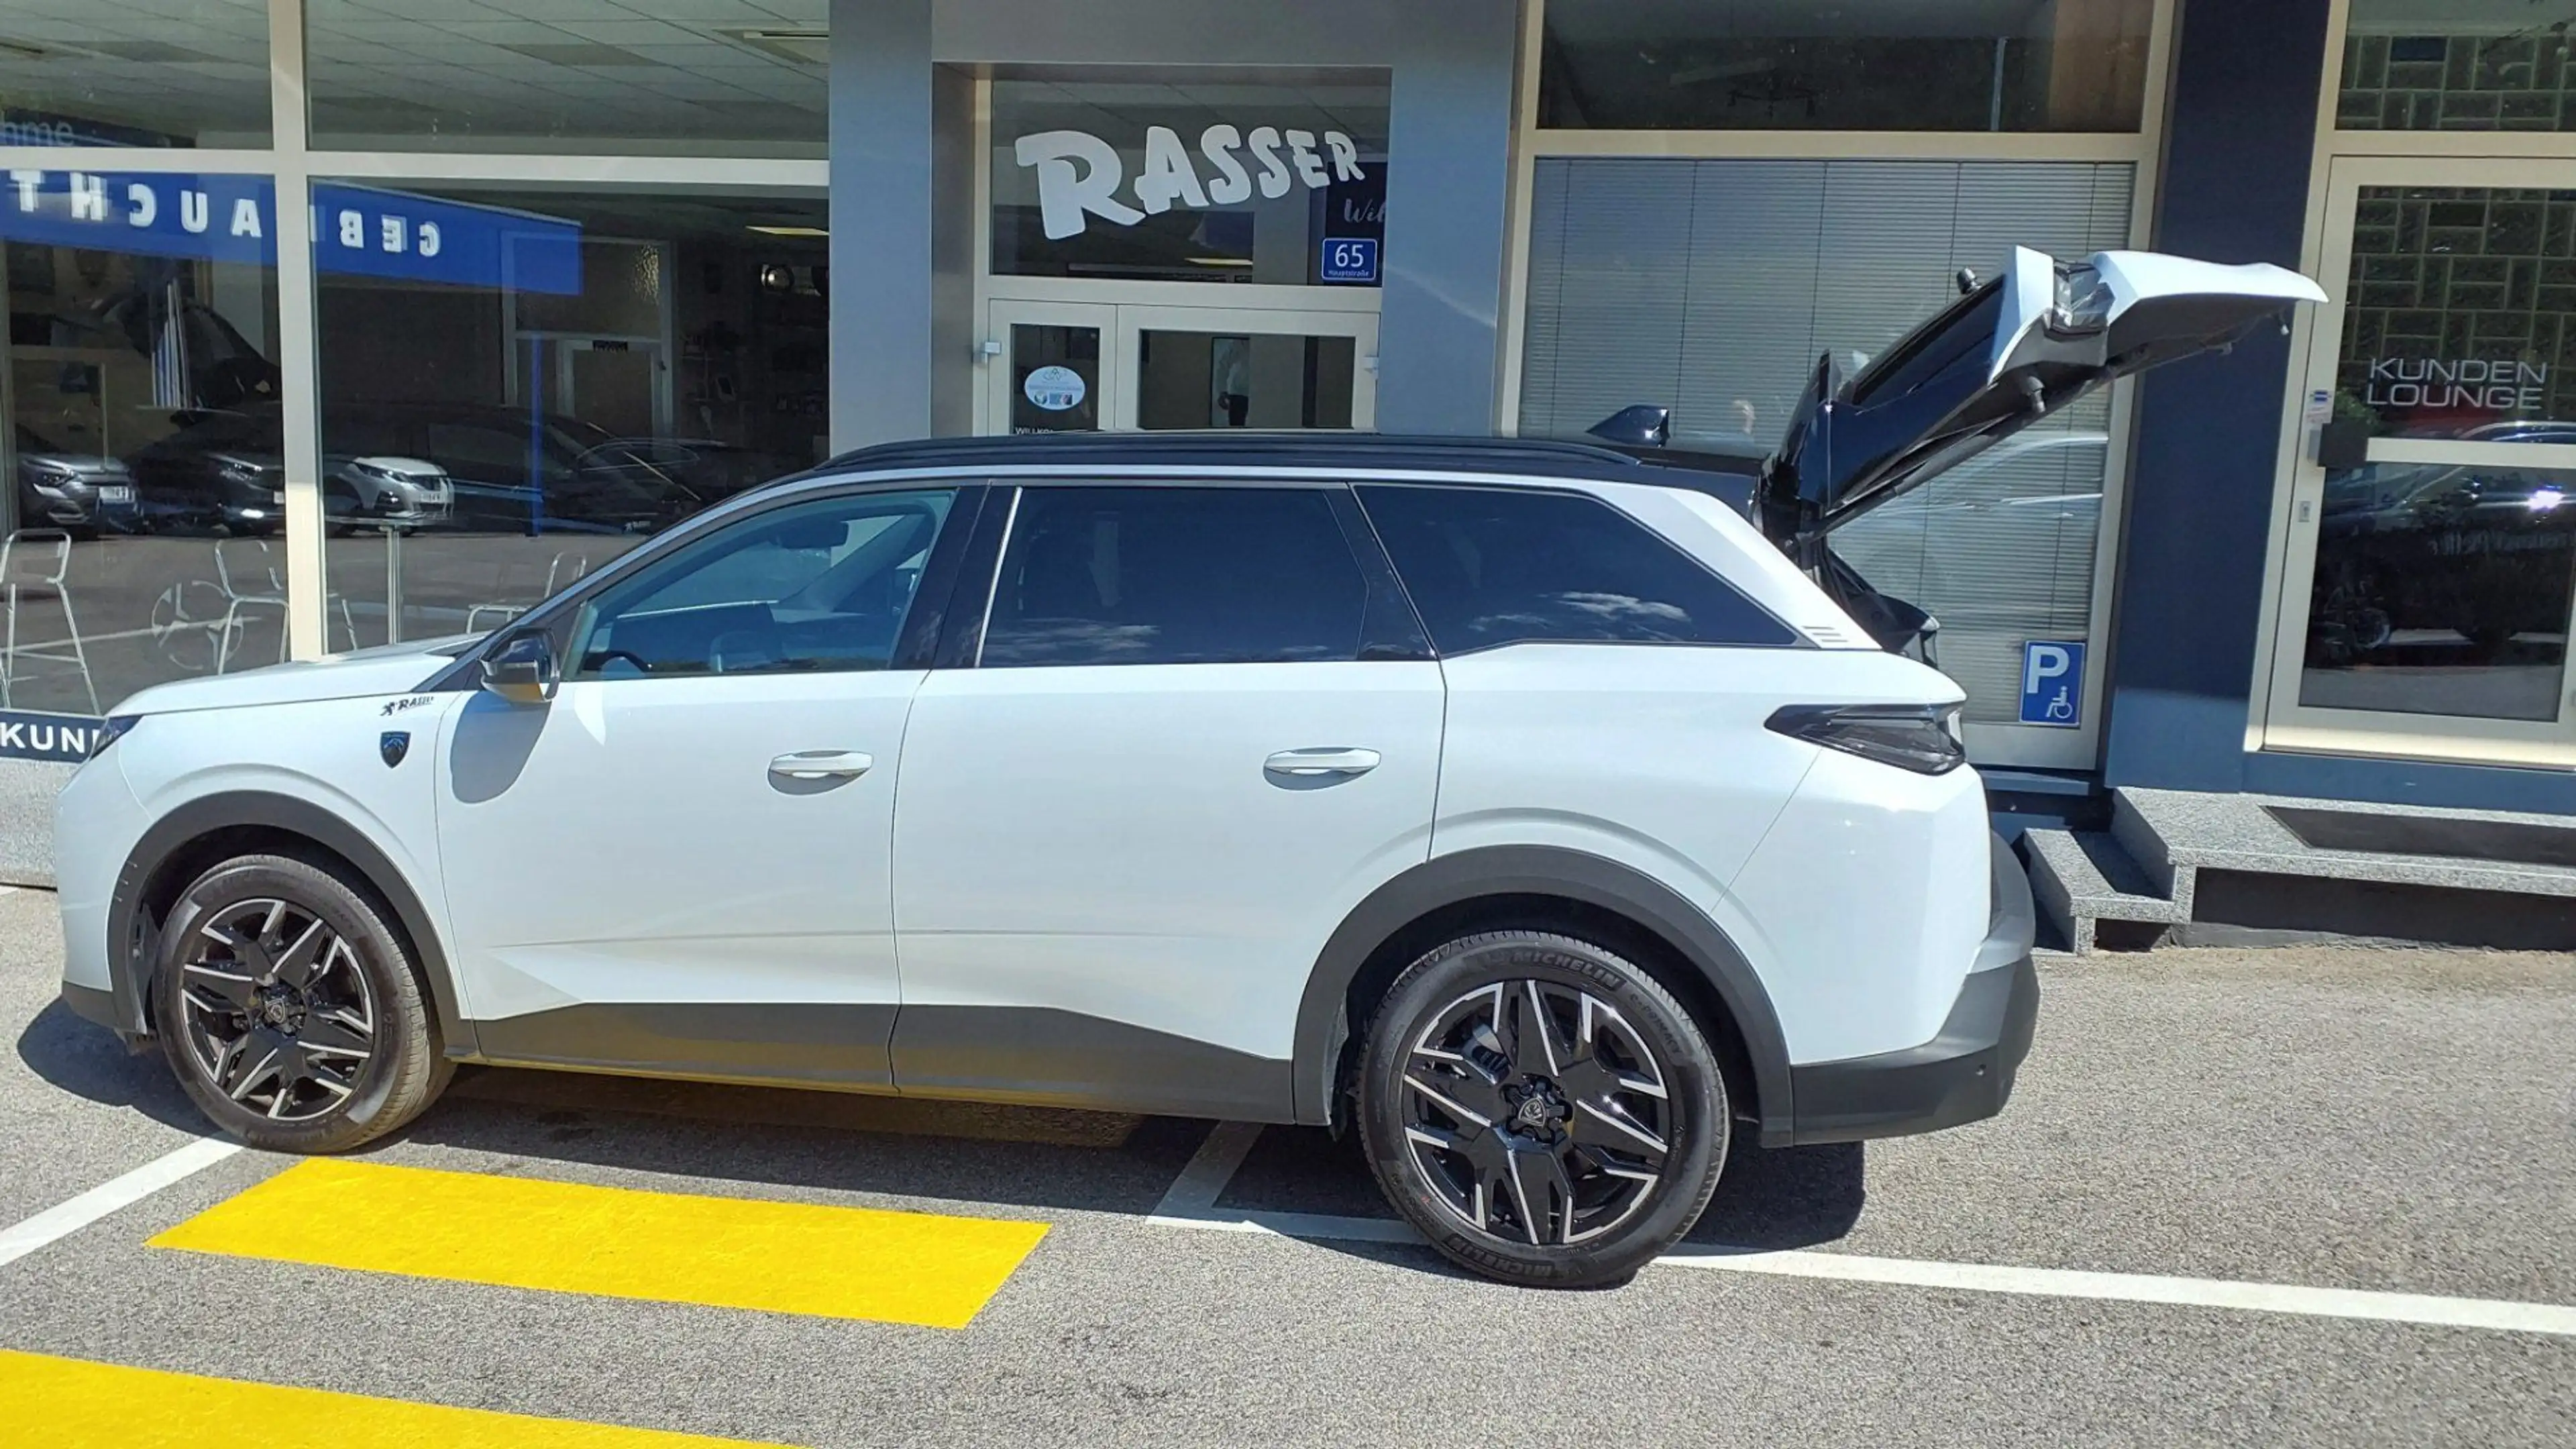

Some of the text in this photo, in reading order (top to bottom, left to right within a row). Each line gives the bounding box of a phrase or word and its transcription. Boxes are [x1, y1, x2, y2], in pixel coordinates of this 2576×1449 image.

[1014, 124, 1365, 240] RASSER
[1335, 244, 1364, 268] 65
[2369, 358, 2547, 384] KUNDEN
[2367, 383, 2544, 410] LOUNGE
[2026, 646, 2070, 694] P
[1511, 951, 1621, 990] MICHELIN
